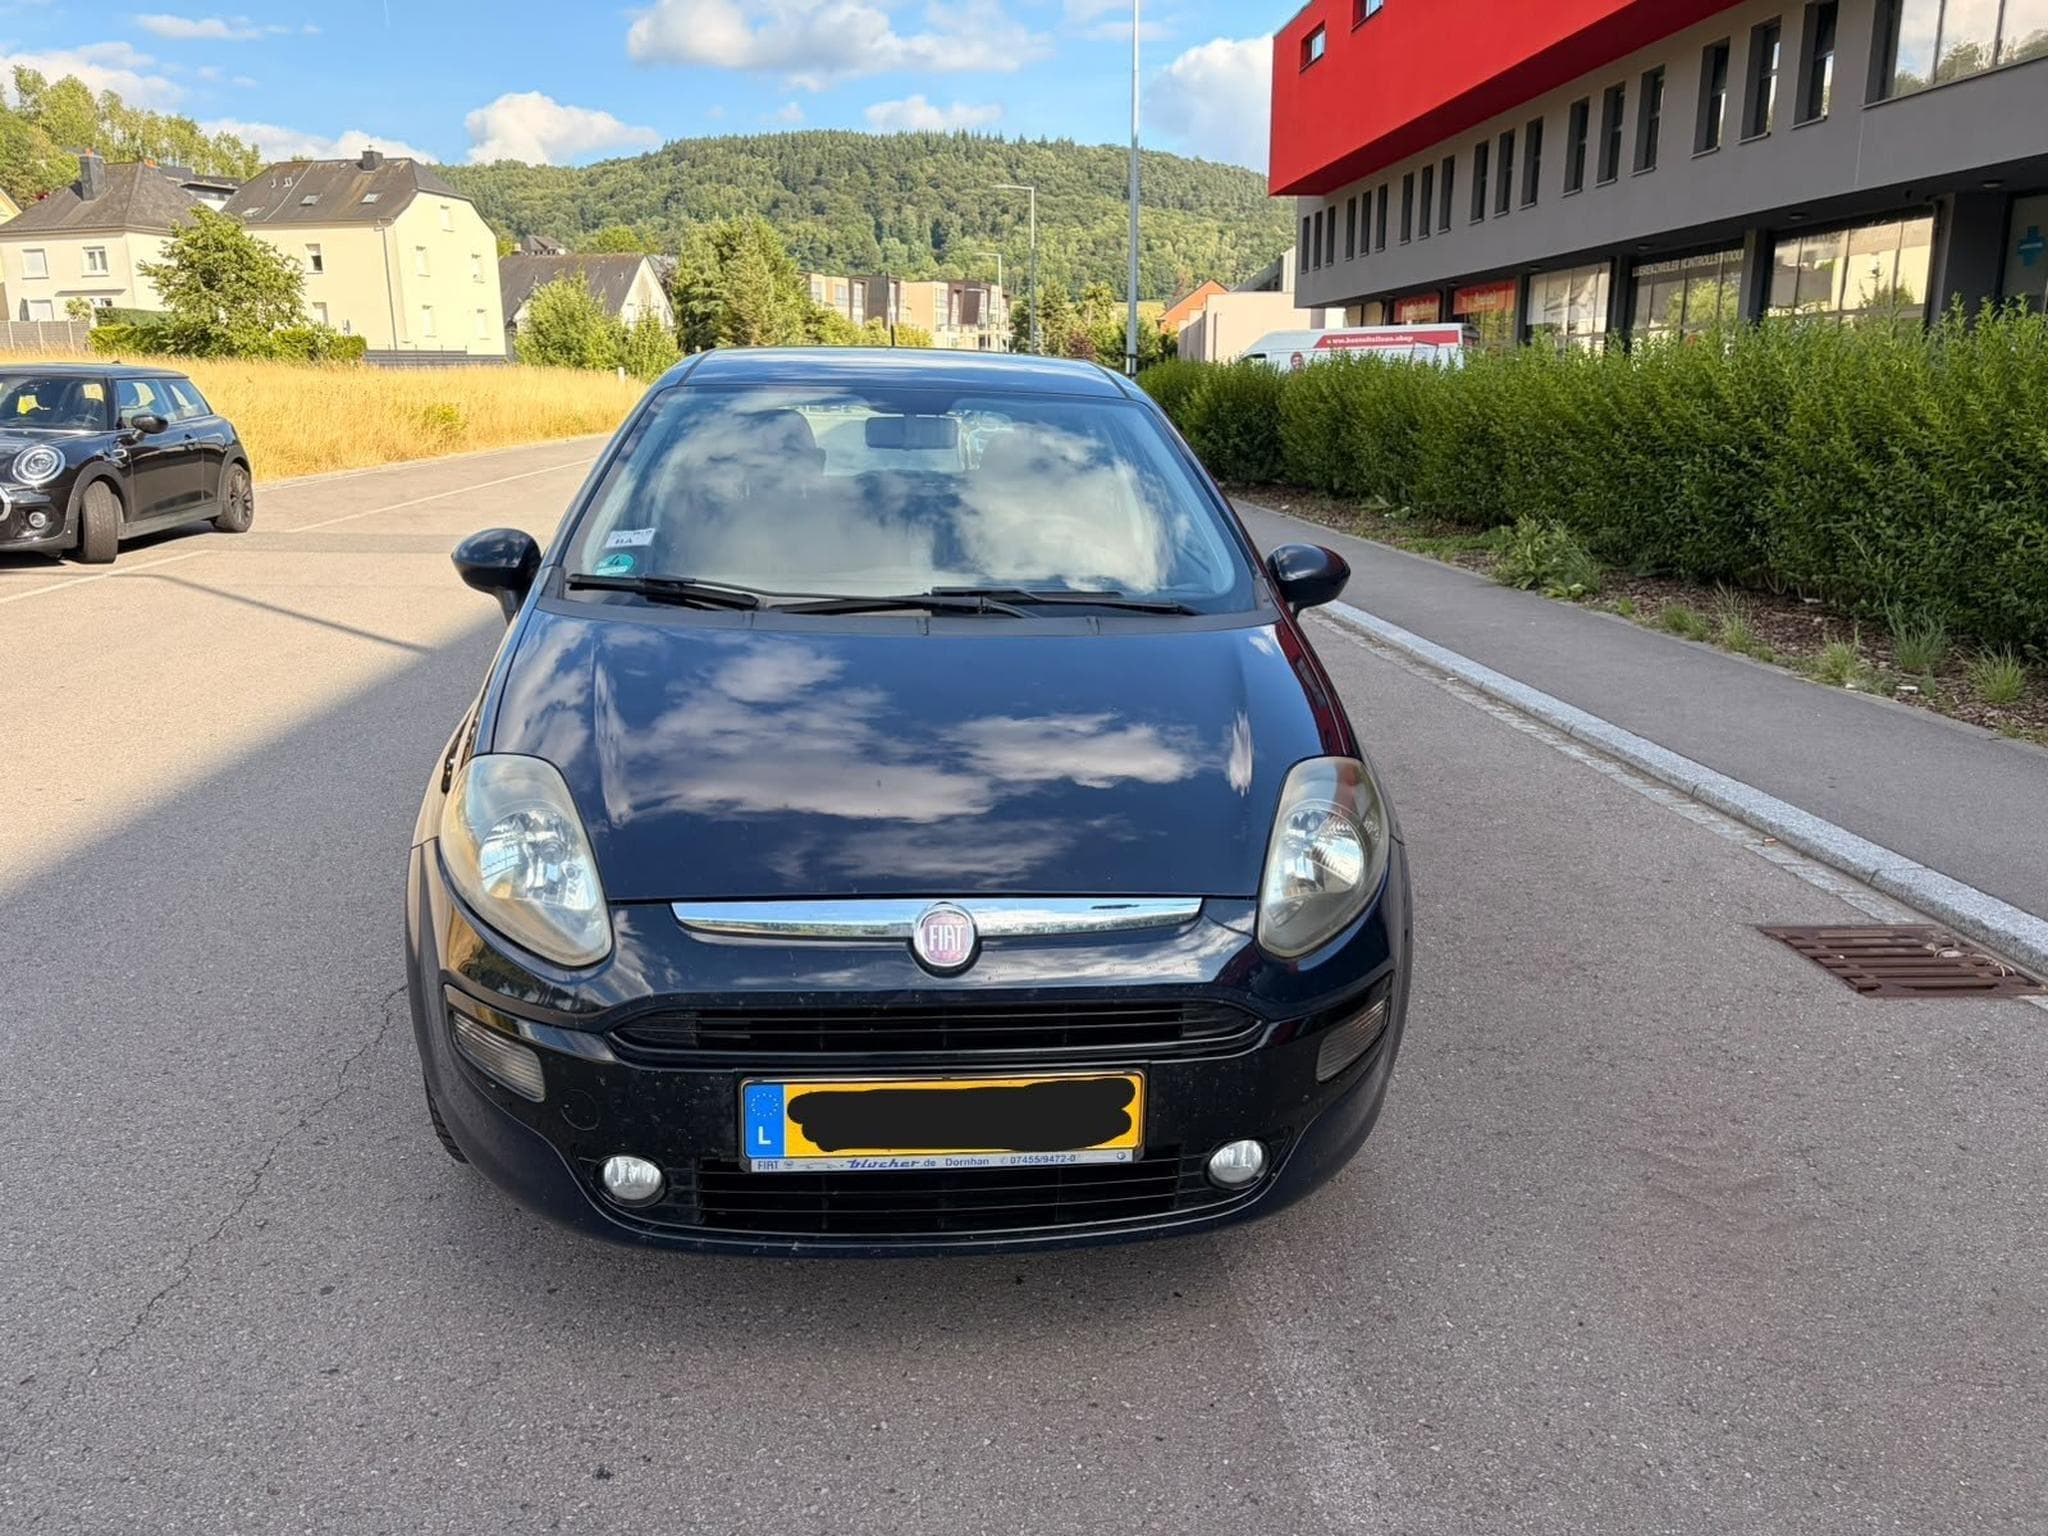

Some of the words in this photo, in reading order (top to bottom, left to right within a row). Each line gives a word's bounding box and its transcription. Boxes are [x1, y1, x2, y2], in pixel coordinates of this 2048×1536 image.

[928, 924, 964, 951] FIAT
[758, 1126, 772, 1144] L
[758, 1160, 778, 1170] FIAT
[945, 1157, 989, 1167] Dornhan
